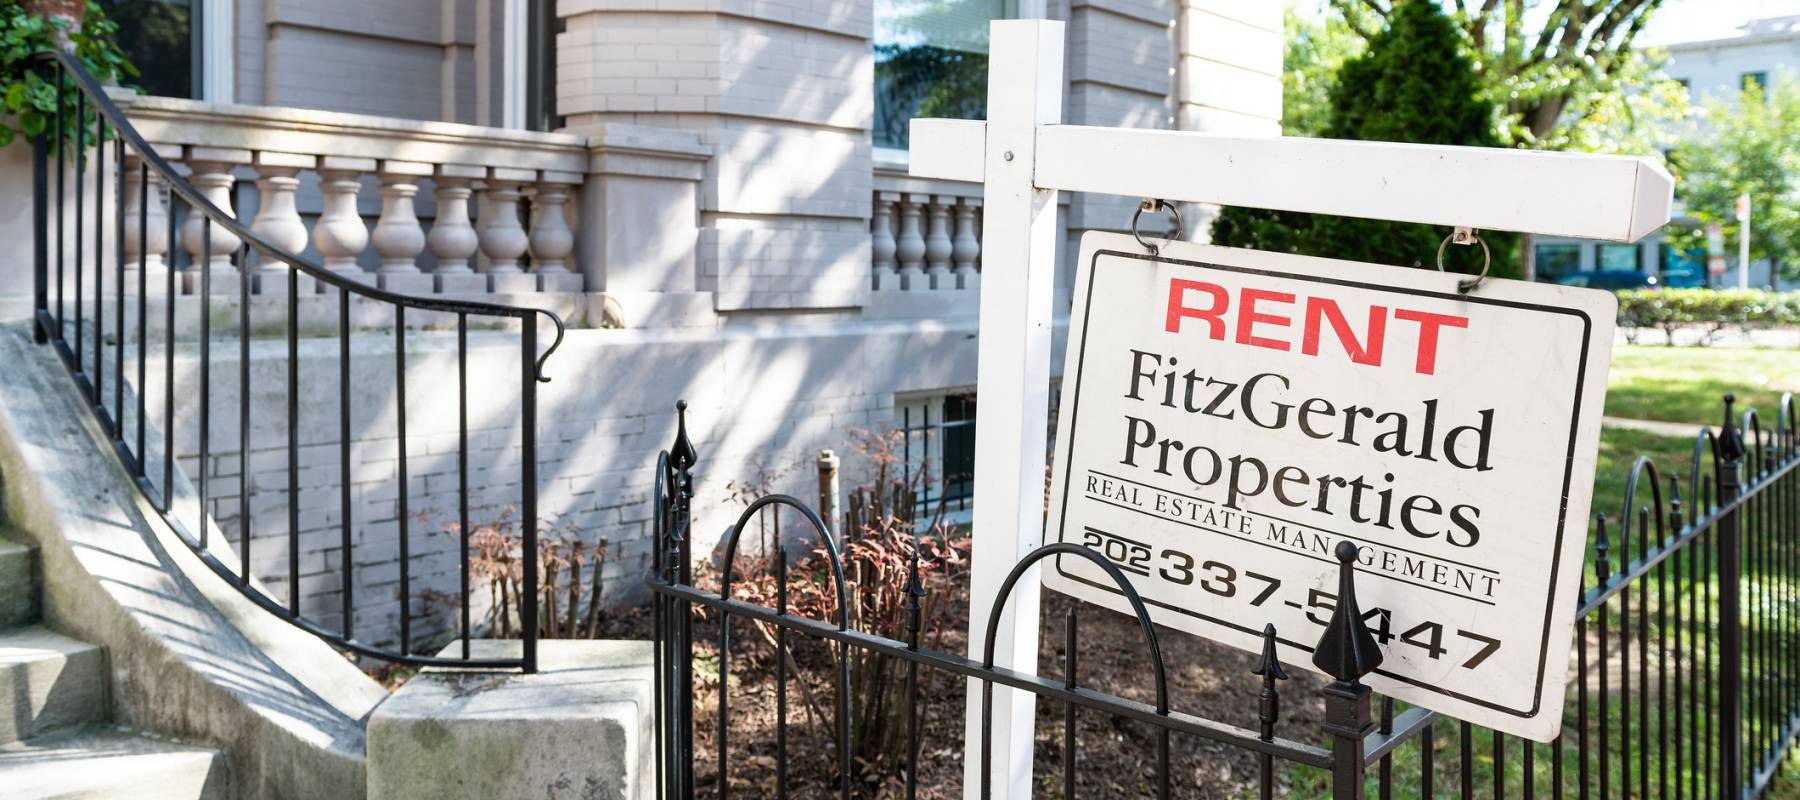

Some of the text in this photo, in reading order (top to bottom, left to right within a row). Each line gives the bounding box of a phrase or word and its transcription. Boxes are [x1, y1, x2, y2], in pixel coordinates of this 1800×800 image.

[1165, 278, 1469, 376] RENT
[1124, 348, 1494, 472] FitzGerald
[1086, 475, 1500, 598] REAL ESTATE MANGEMENT
[1119, 415, 1482, 548] Properties
[1083, 532, 1502, 671] 202 337-5447
